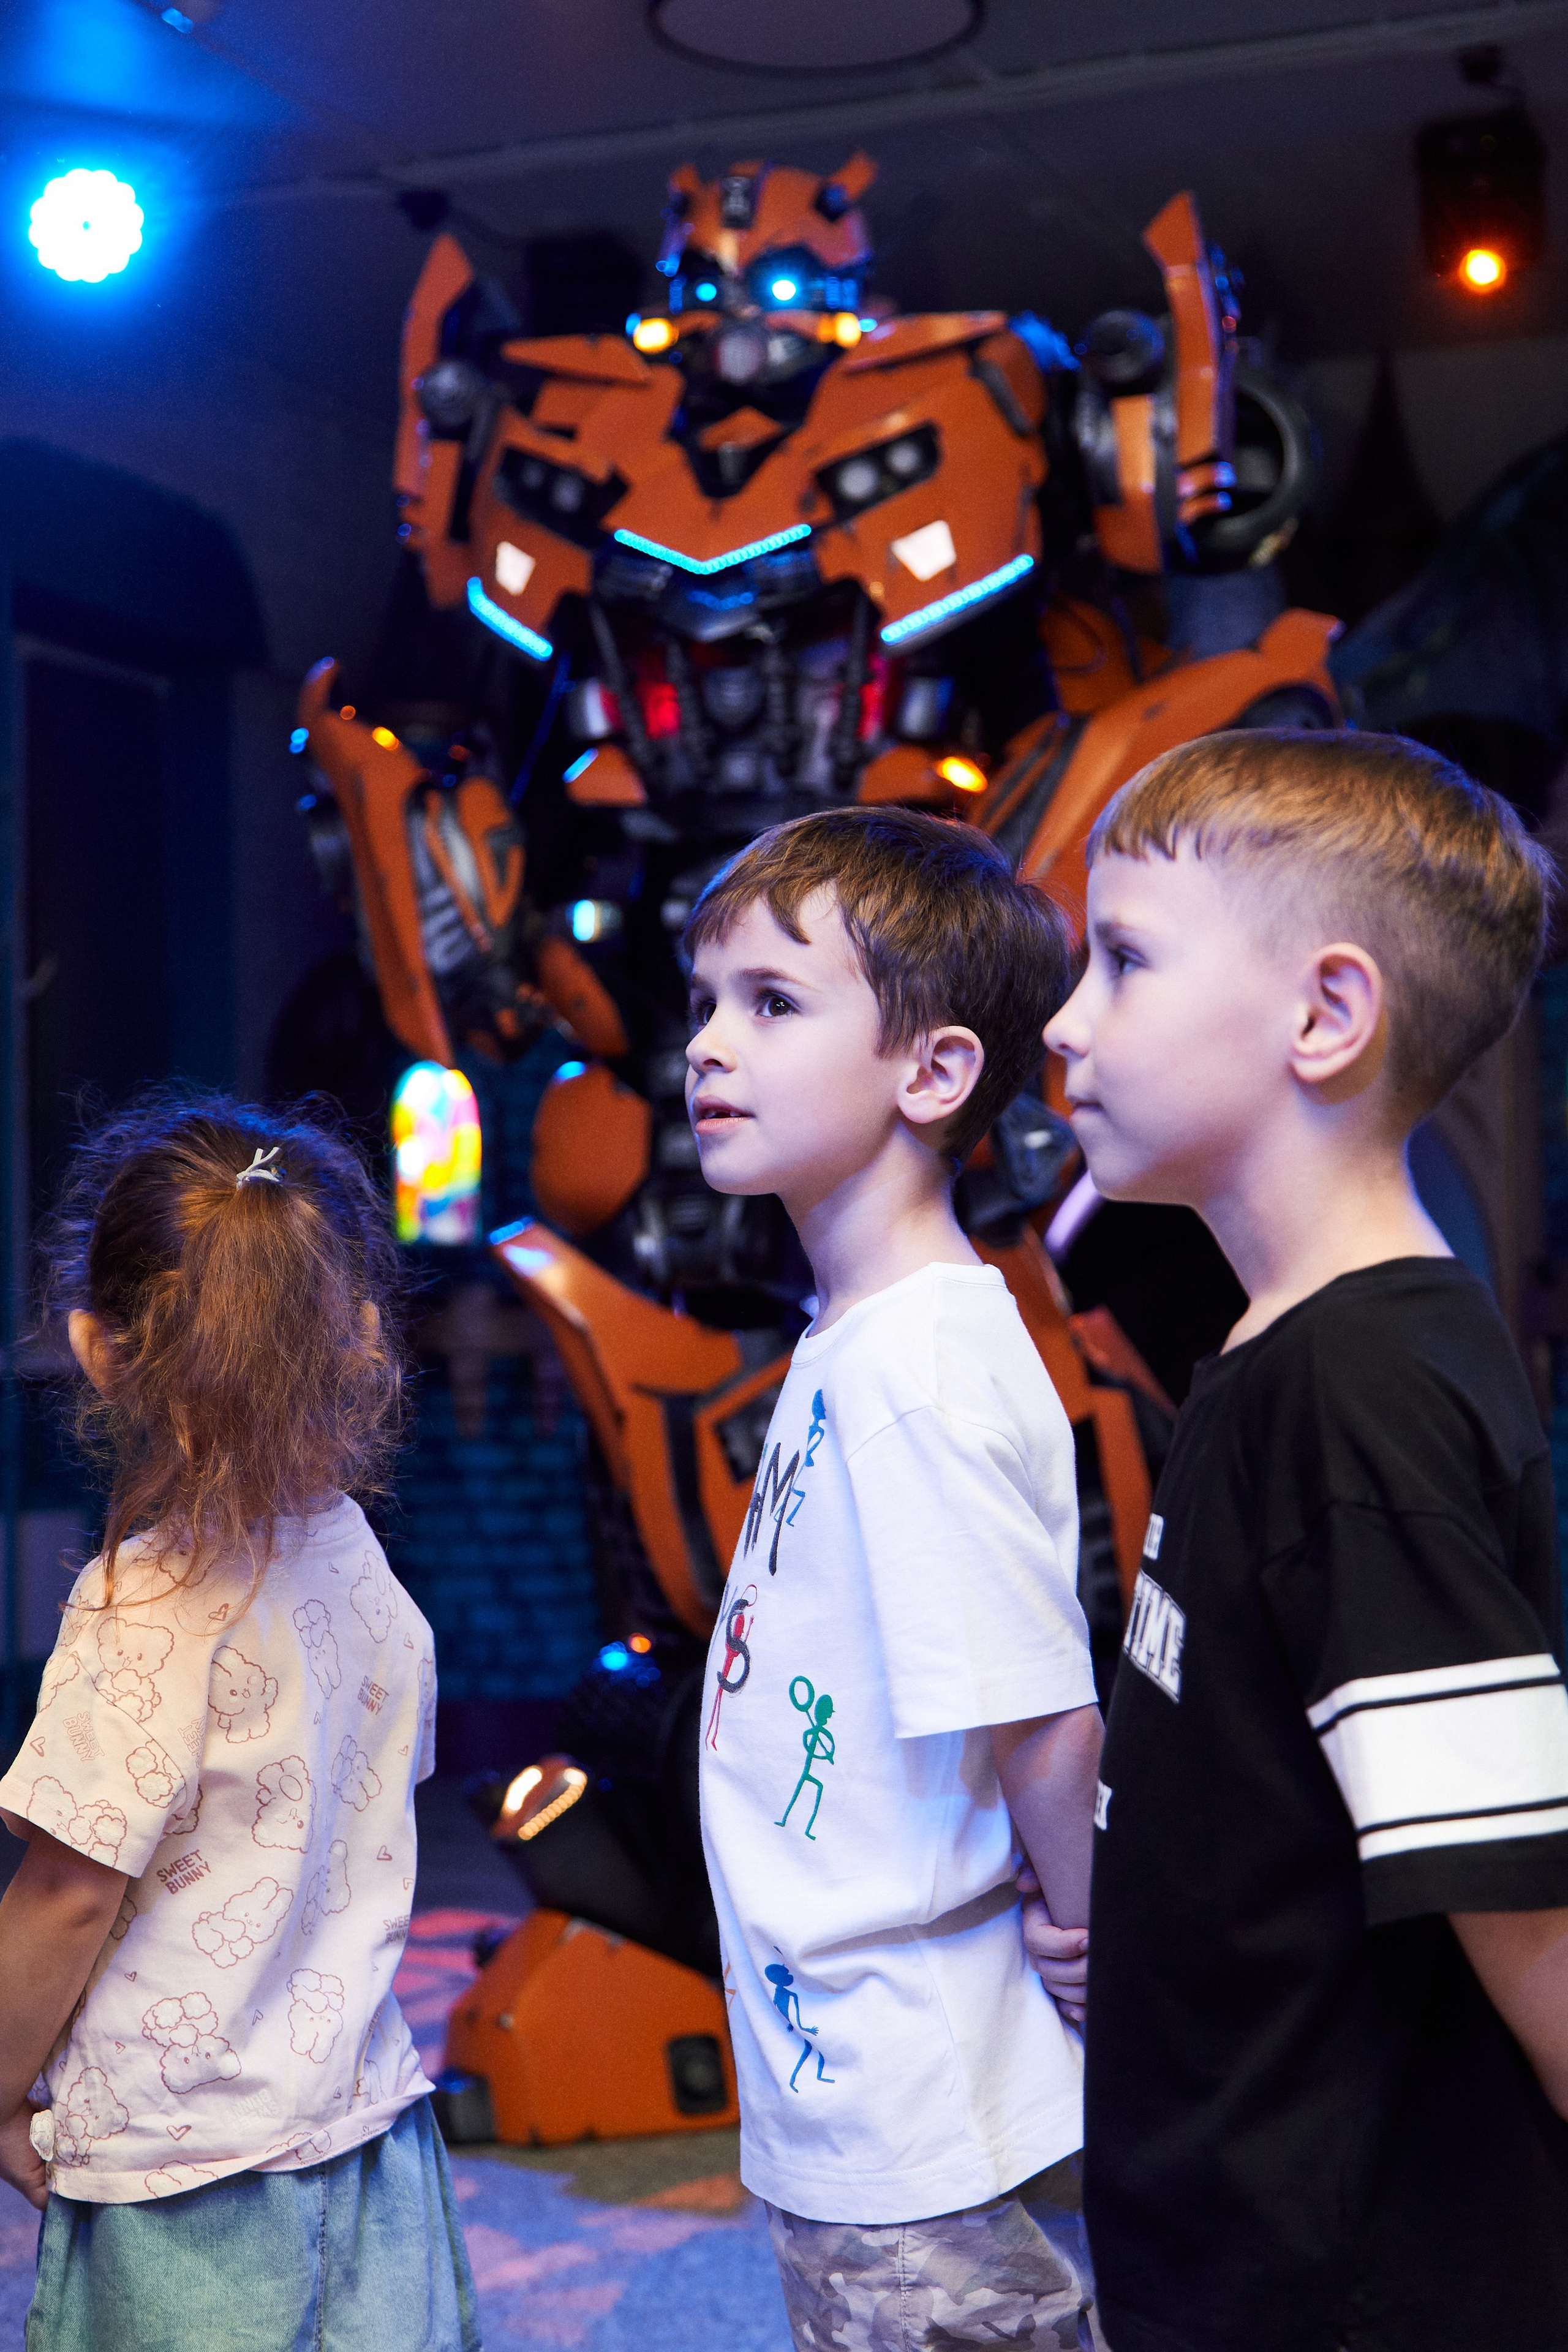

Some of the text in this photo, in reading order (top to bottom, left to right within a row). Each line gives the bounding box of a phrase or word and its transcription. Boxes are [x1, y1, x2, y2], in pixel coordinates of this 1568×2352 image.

[358, 1687, 383, 1716] BUNNY
[361, 1675, 390, 1703] SWEET
[62, 1716, 96, 1762] BUNNY
[77, 1711, 105, 1757] SWEET
[156, 1849, 203, 1883] SWEET
[165, 1861, 212, 1895] BUNNY
